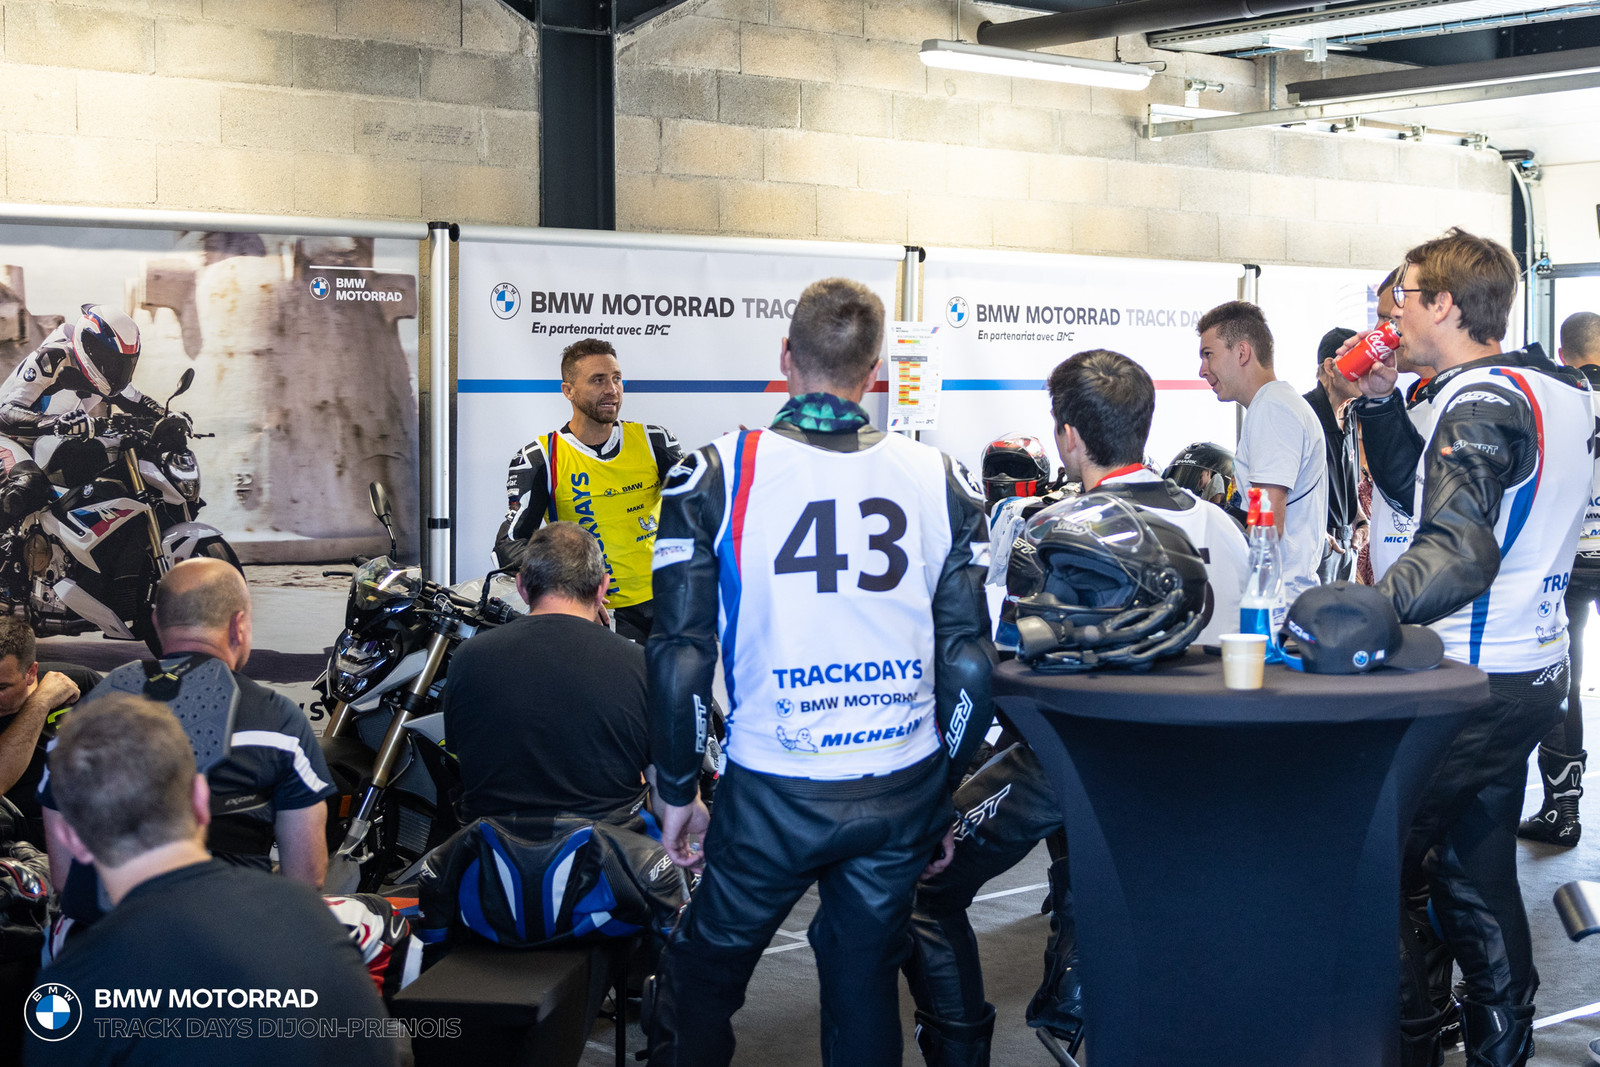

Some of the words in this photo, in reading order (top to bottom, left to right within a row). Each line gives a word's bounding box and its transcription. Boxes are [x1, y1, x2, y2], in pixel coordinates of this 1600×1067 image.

[336, 278, 366, 288] BMW
[336, 290, 403, 302] MOTORRAD
[531, 291, 594, 314] BMW
[602, 293, 735, 318] MOTORRAD
[742, 298, 798, 319] TRAC
[976, 304, 1020, 323] BMW
[1026, 305, 1121, 325] MOTORRAD
[1126, 308, 1177, 327] TRACK
[531, 322, 546, 334] En
[549, 323, 615, 336] partenariat
[616, 327, 642, 336] avec
[644, 324, 671, 336] BMC
[978, 330, 988, 340] En
[990, 331, 1035, 342] partenariat
[1037, 333, 1054, 342] avec
[1446, 391, 1511, 413] RST
[621, 482, 643, 492] BMW
[626, 504, 645, 513] MAKE
[774, 496, 909, 593] 43
[772, 658, 923, 690] TRACKDAYS
[800, 697, 839, 713] BMW
[693, 693, 707, 753] RST
[945, 688, 973, 759] RST
